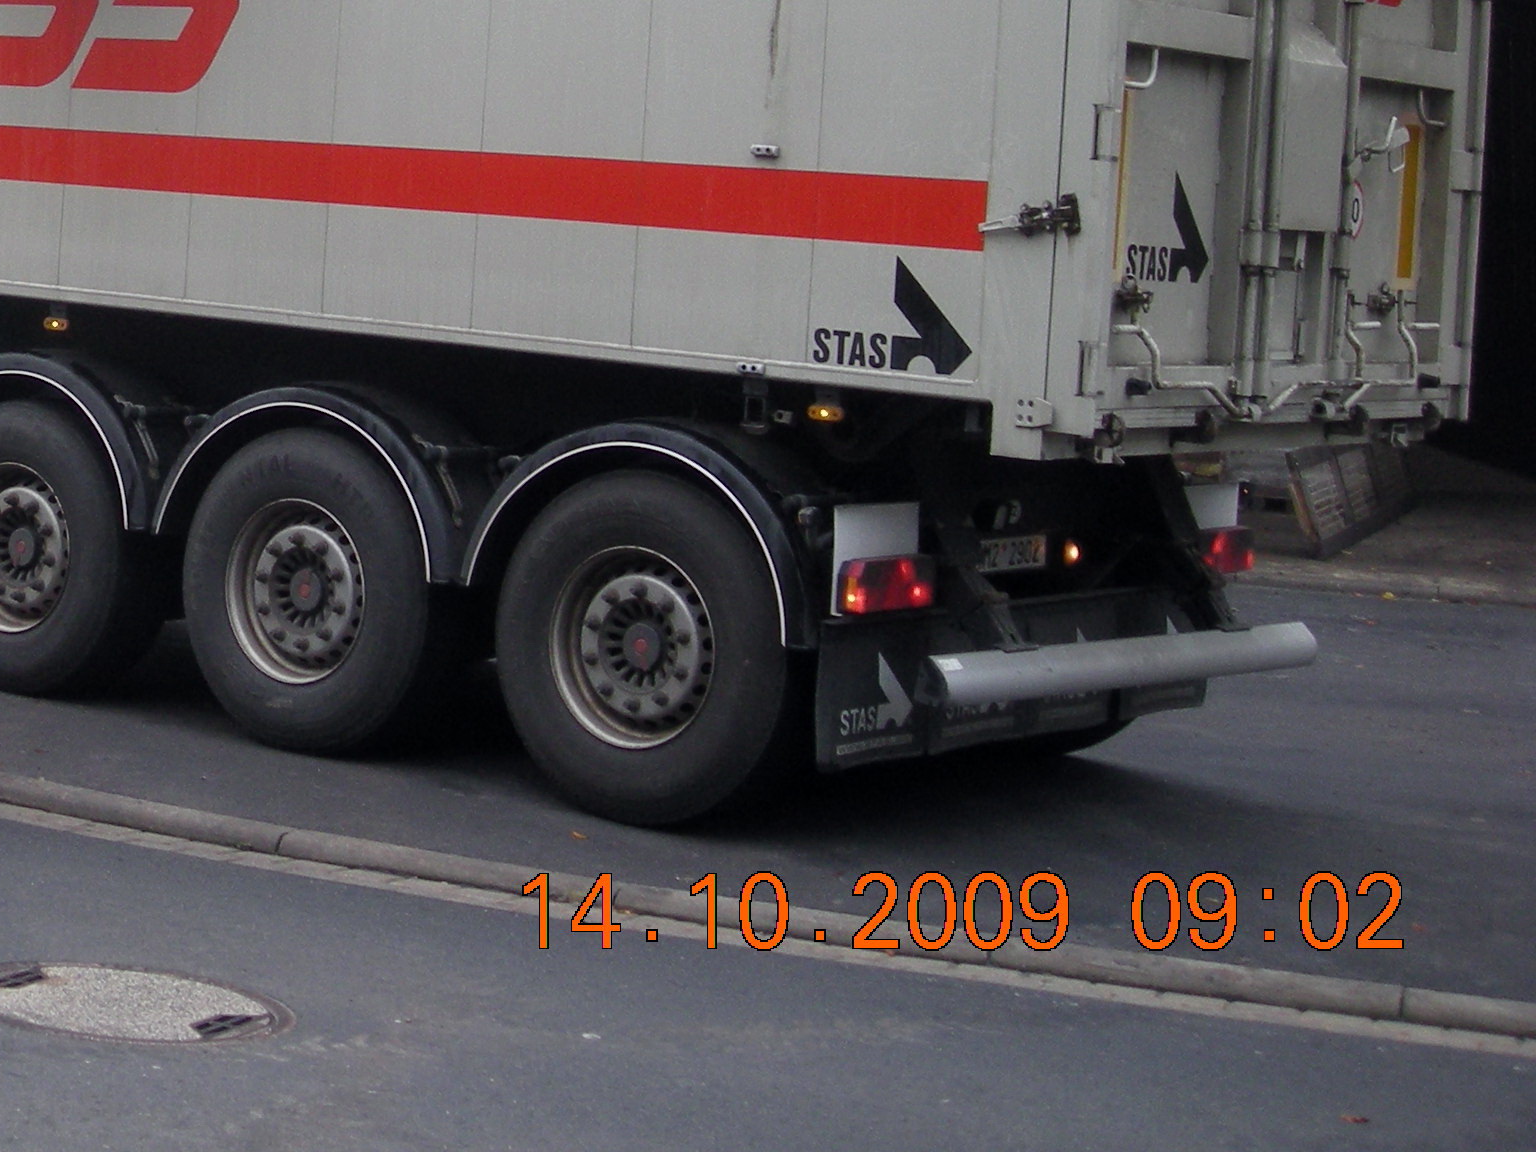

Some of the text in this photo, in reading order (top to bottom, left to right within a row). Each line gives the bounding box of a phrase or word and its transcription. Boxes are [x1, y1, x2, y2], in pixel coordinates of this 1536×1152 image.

[1125, 244, 1169, 282] STAS
[813, 328, 888, 369] STAS
[839, 705, 878, 737] STAS
